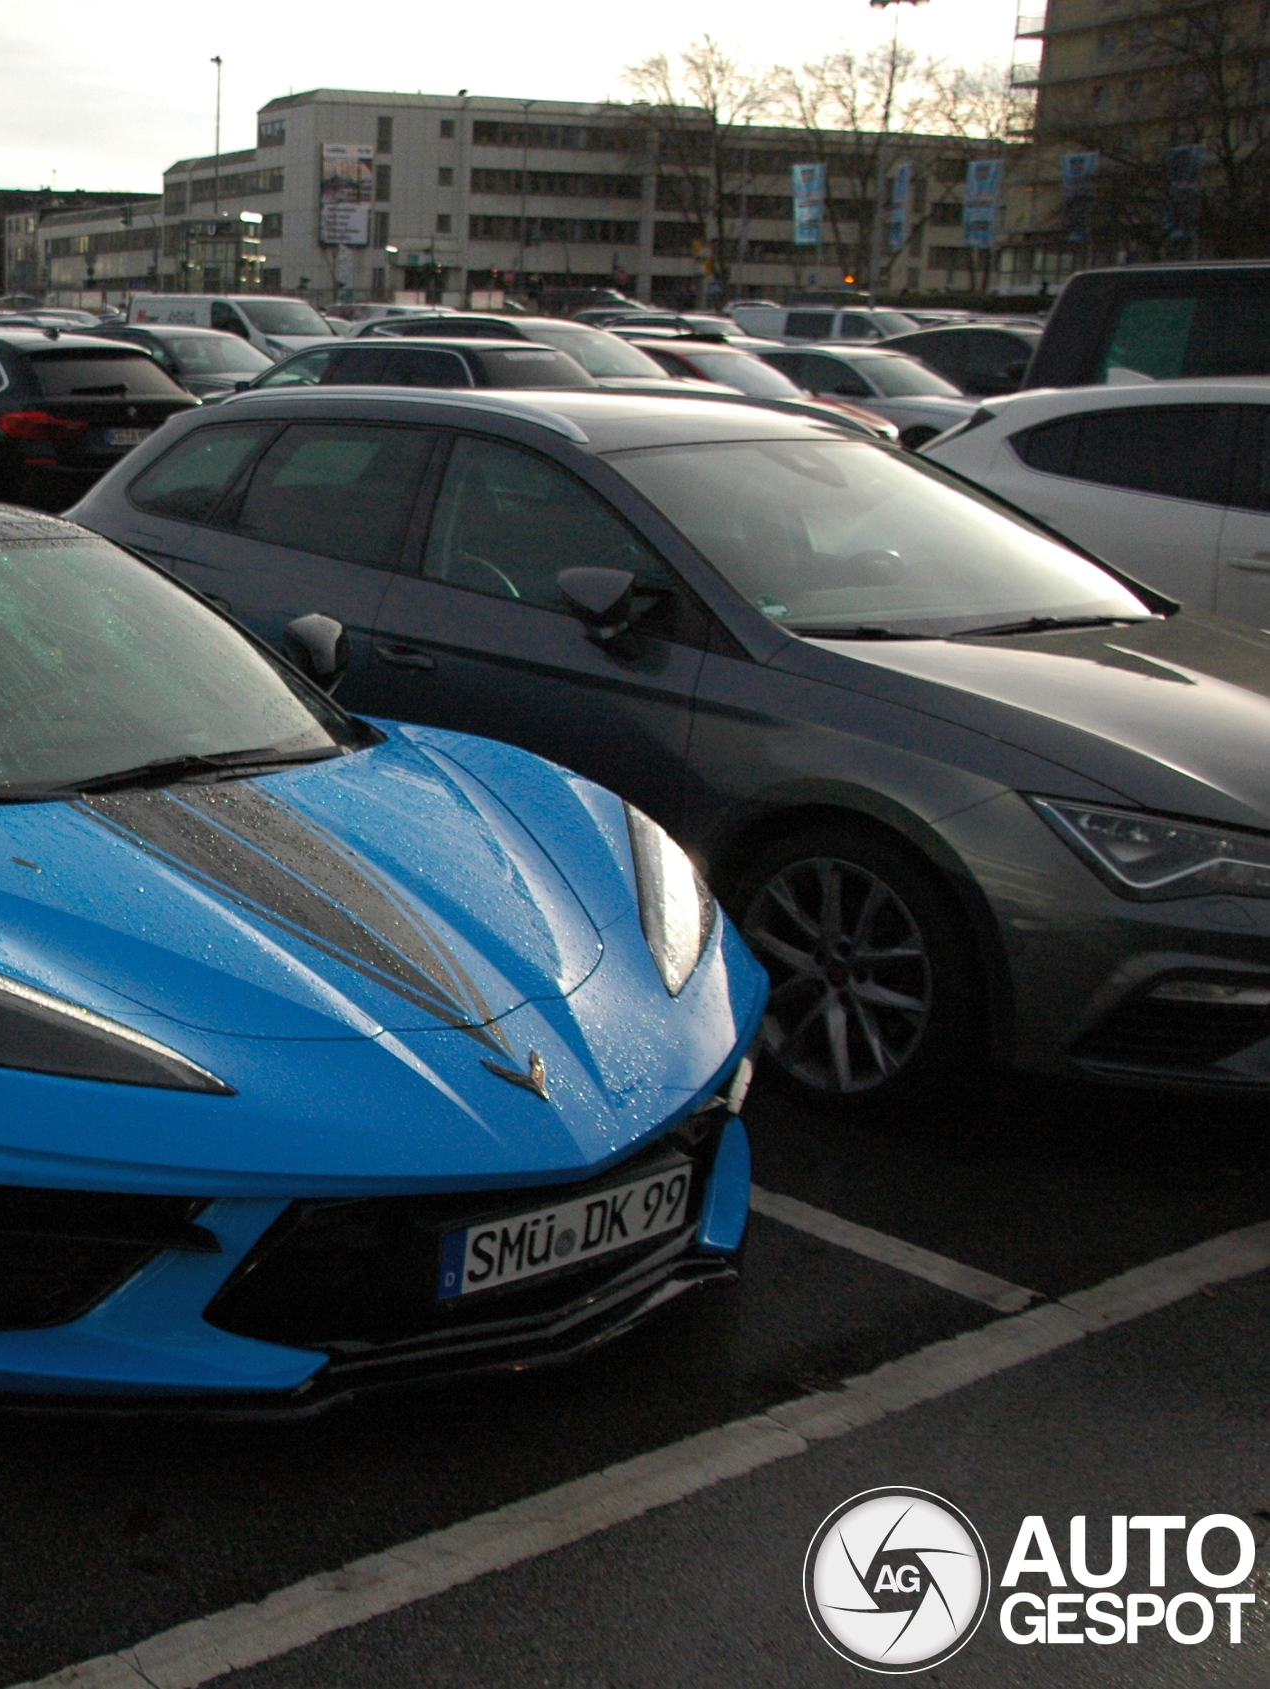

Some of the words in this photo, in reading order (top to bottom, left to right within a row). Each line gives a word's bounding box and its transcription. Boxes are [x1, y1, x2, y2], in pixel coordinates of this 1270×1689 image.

[467, 1213, 557, 1283] SMÜ
[580, 1189, 635, 1251] DK
[642, 1173, 688, 1232] 99
[444, 1271, 456, 1288] D
